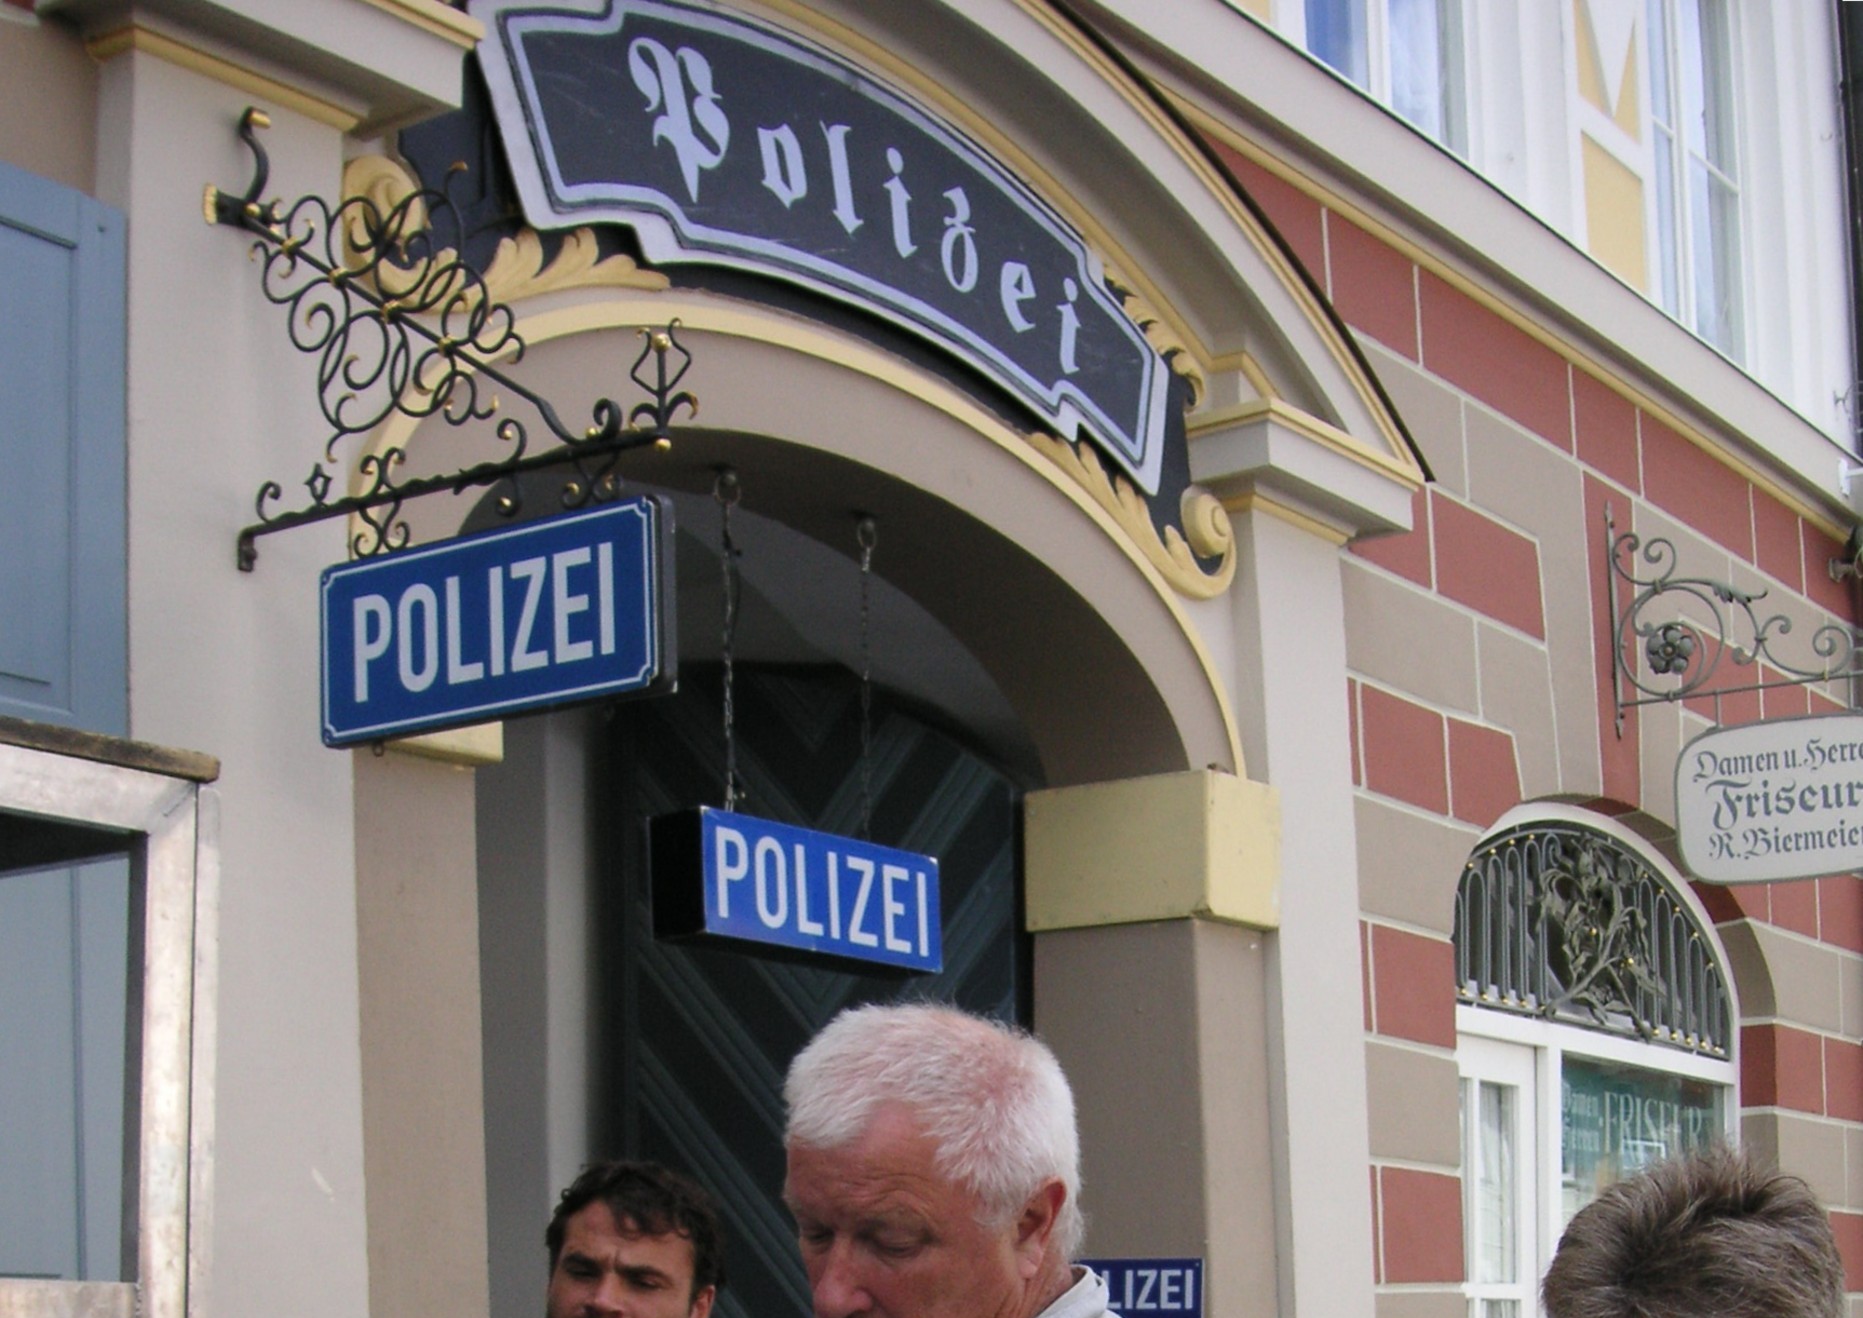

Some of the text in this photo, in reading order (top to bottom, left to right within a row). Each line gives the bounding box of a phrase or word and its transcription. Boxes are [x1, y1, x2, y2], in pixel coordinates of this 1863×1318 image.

[628, 36, 1082, 376] Polizei
[352, 541, 616, 703] POLIZEI
[1692, 750, 1779, 783] Damen
[715, 825, 929, 958] POLIZEI
[1742, 819, 1863, 860] Biermeie
